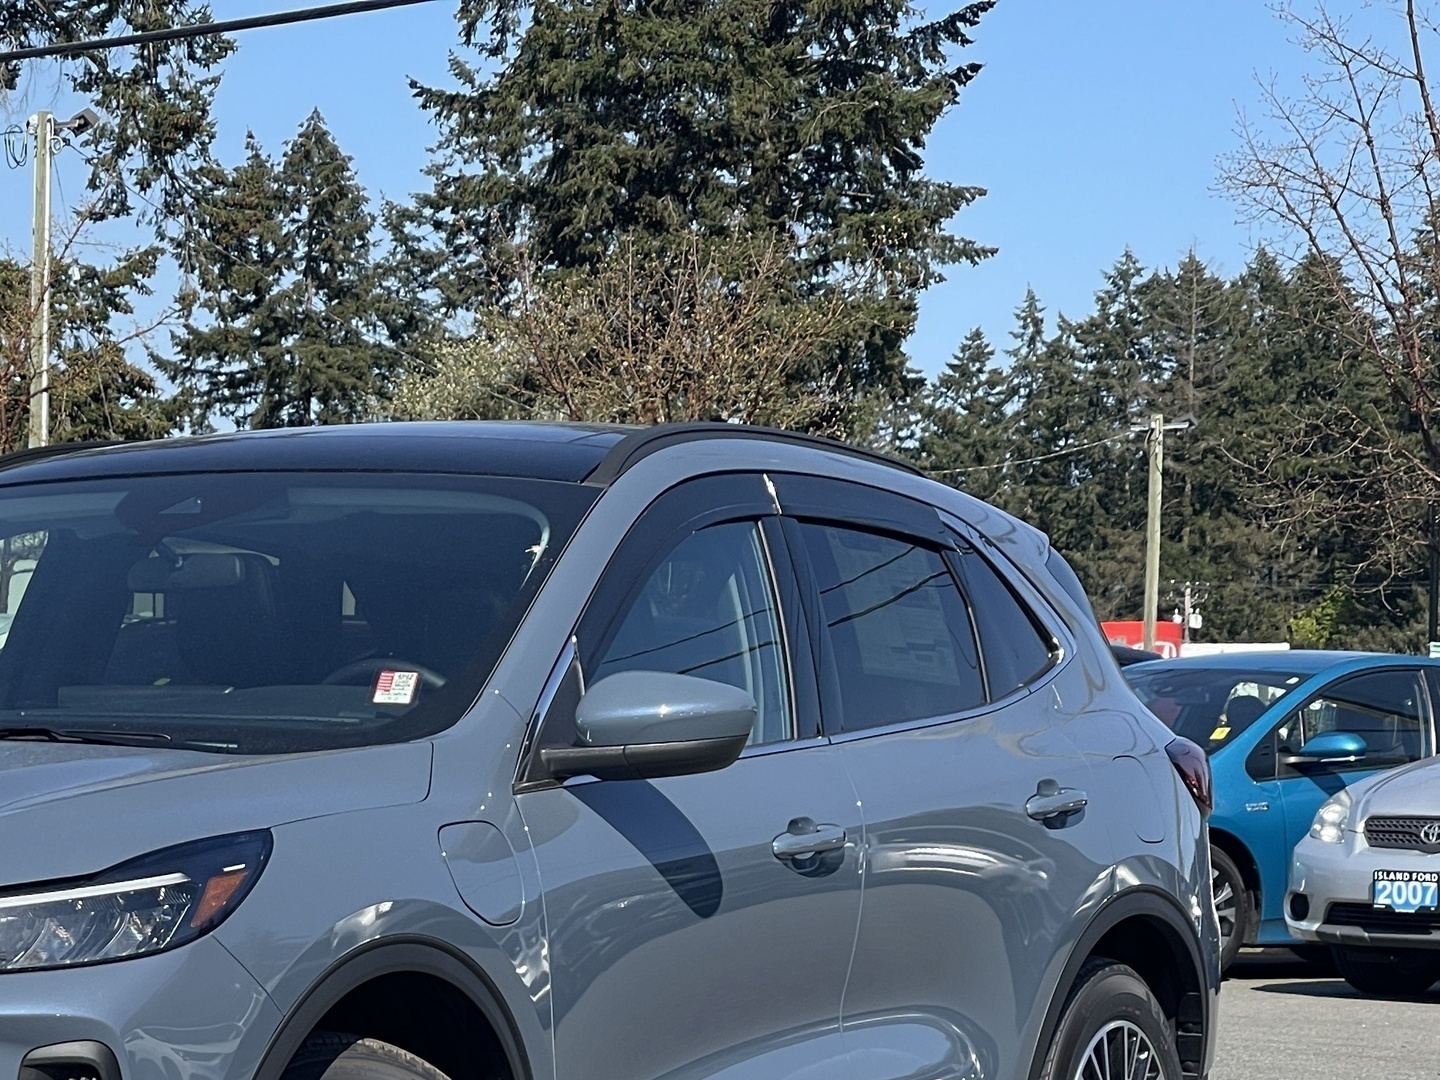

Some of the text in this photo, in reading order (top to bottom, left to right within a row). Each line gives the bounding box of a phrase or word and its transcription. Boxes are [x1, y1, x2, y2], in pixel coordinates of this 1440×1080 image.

[1374, 870, 1439, 882] ISLAND FORD
[1377, 881, 1438, 905] 2007
